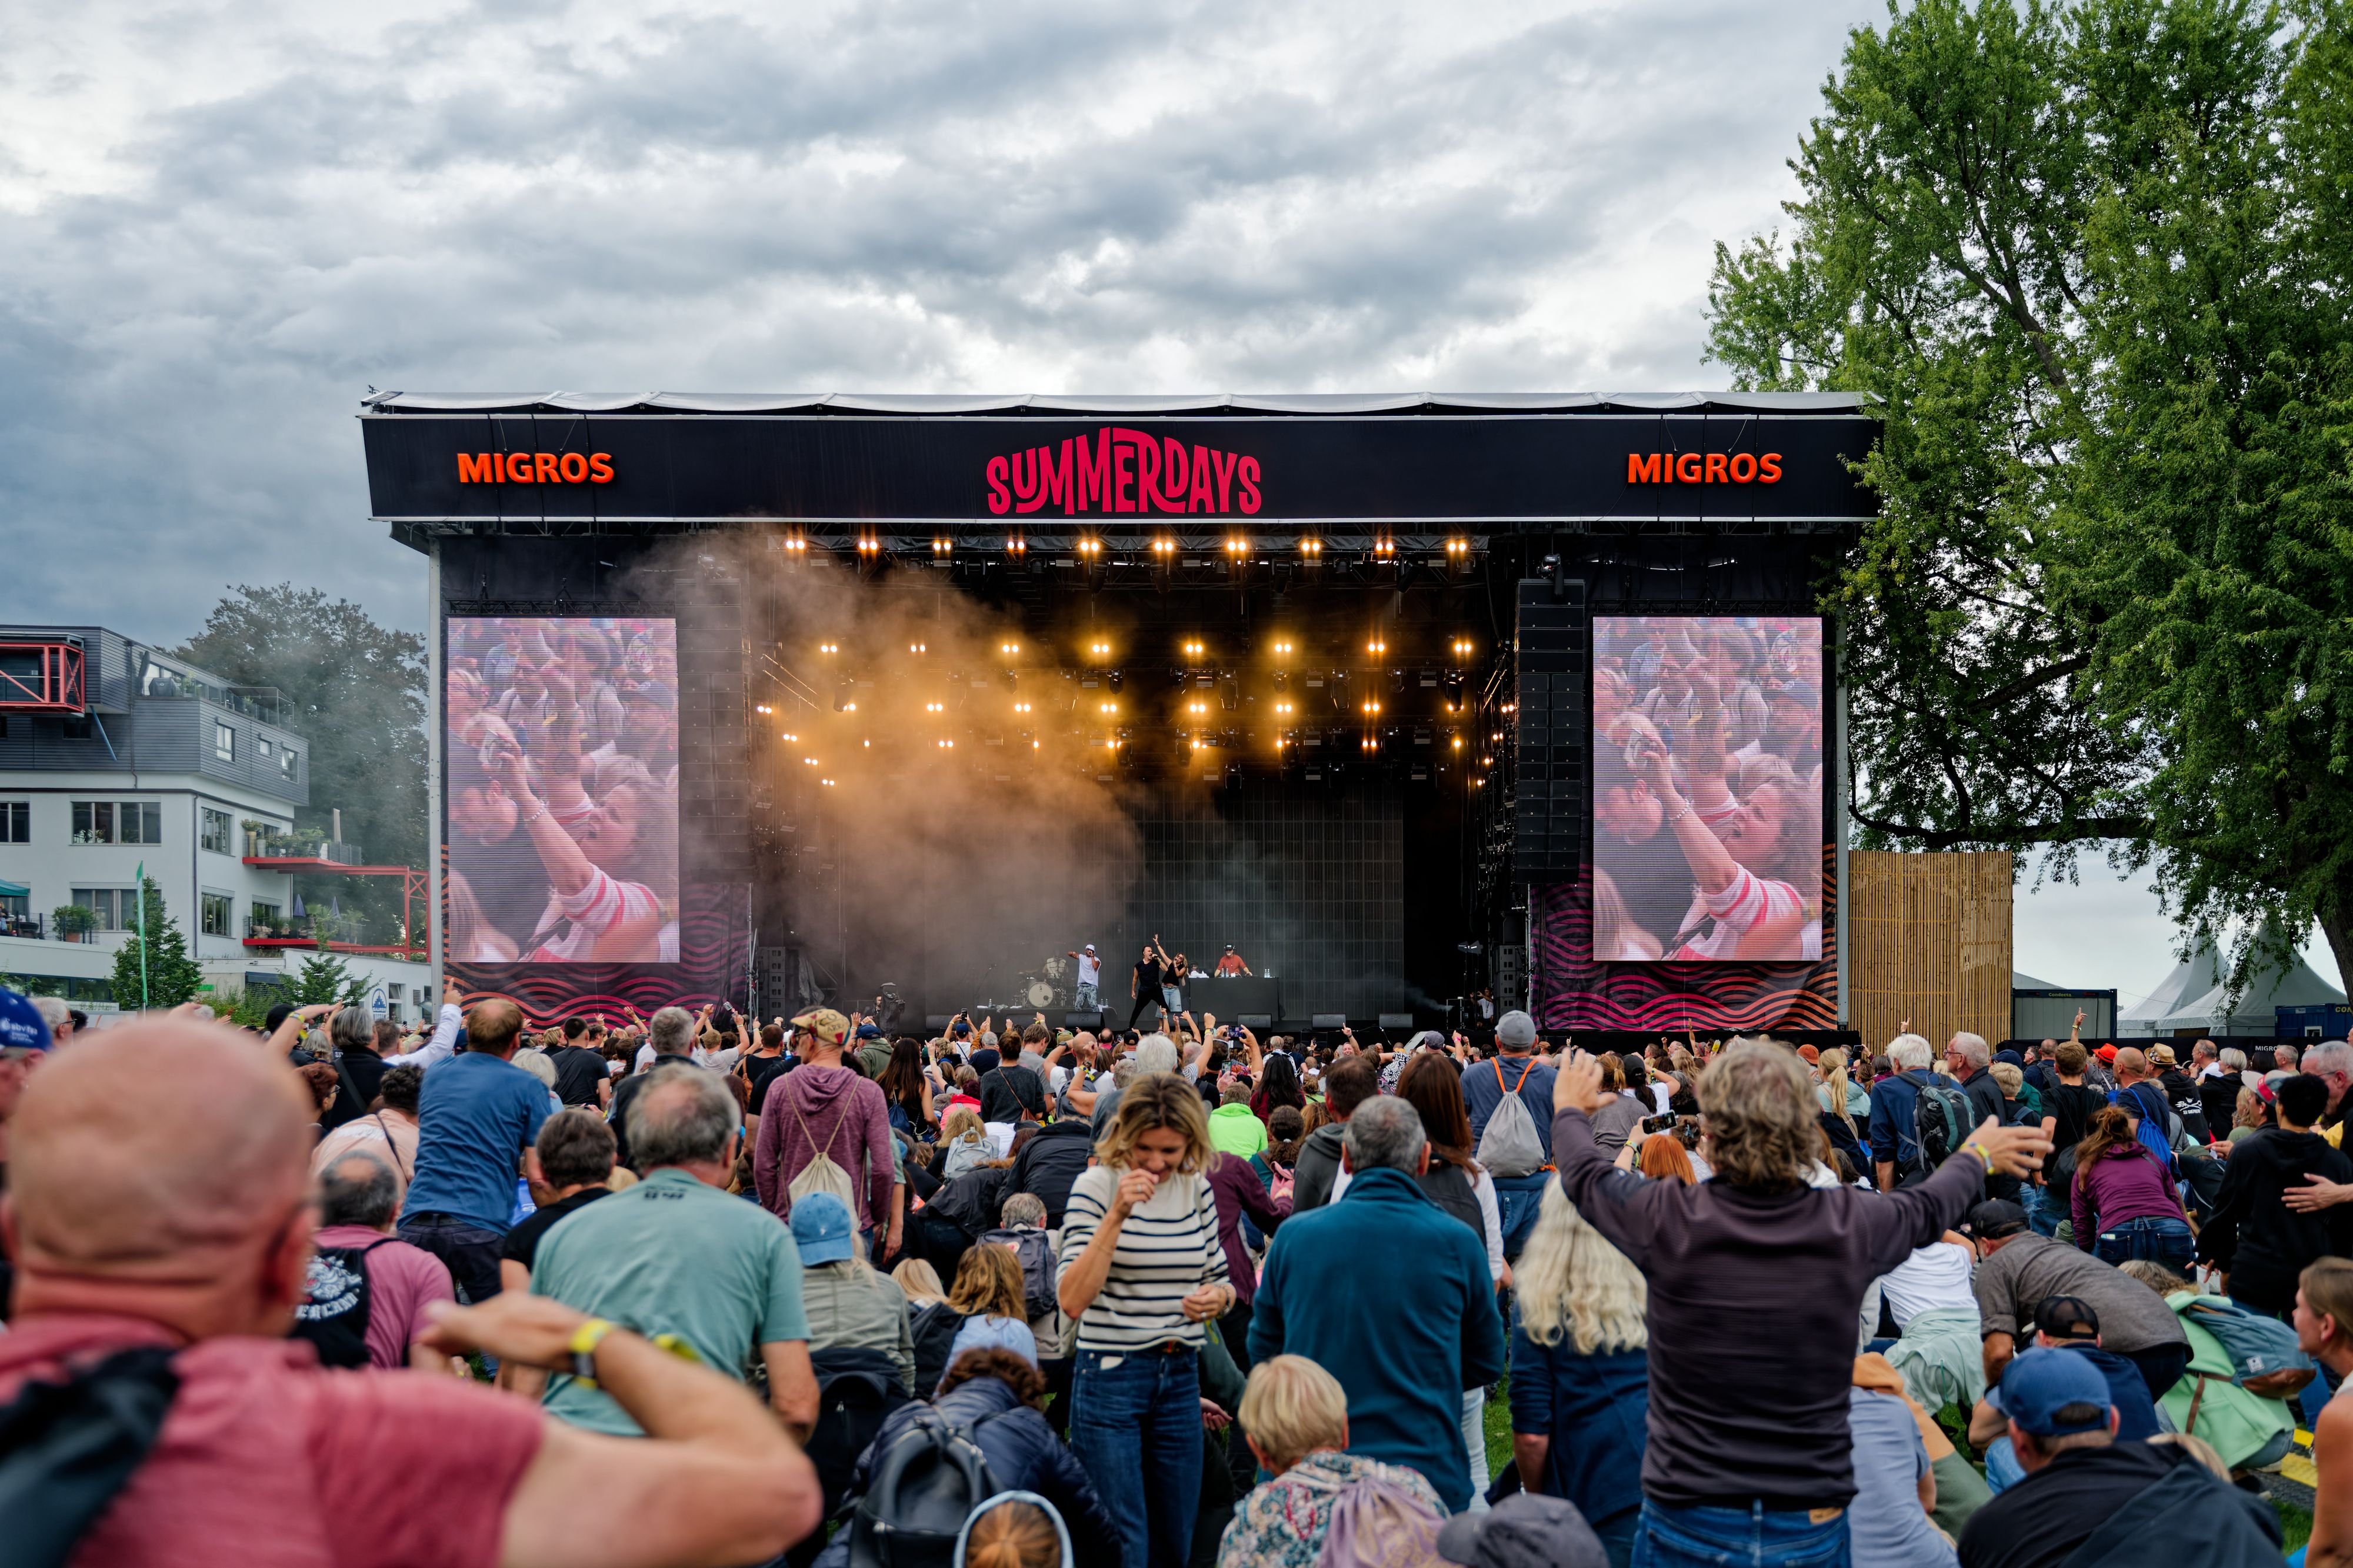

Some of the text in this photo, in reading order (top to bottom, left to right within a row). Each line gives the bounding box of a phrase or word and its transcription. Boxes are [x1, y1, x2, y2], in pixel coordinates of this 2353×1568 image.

[457, 452, 614, 483] MIGROS
[986, 426, 1262, 515] SUMMERDAYS
[1628, 453, 1782, 483] MIGROS
